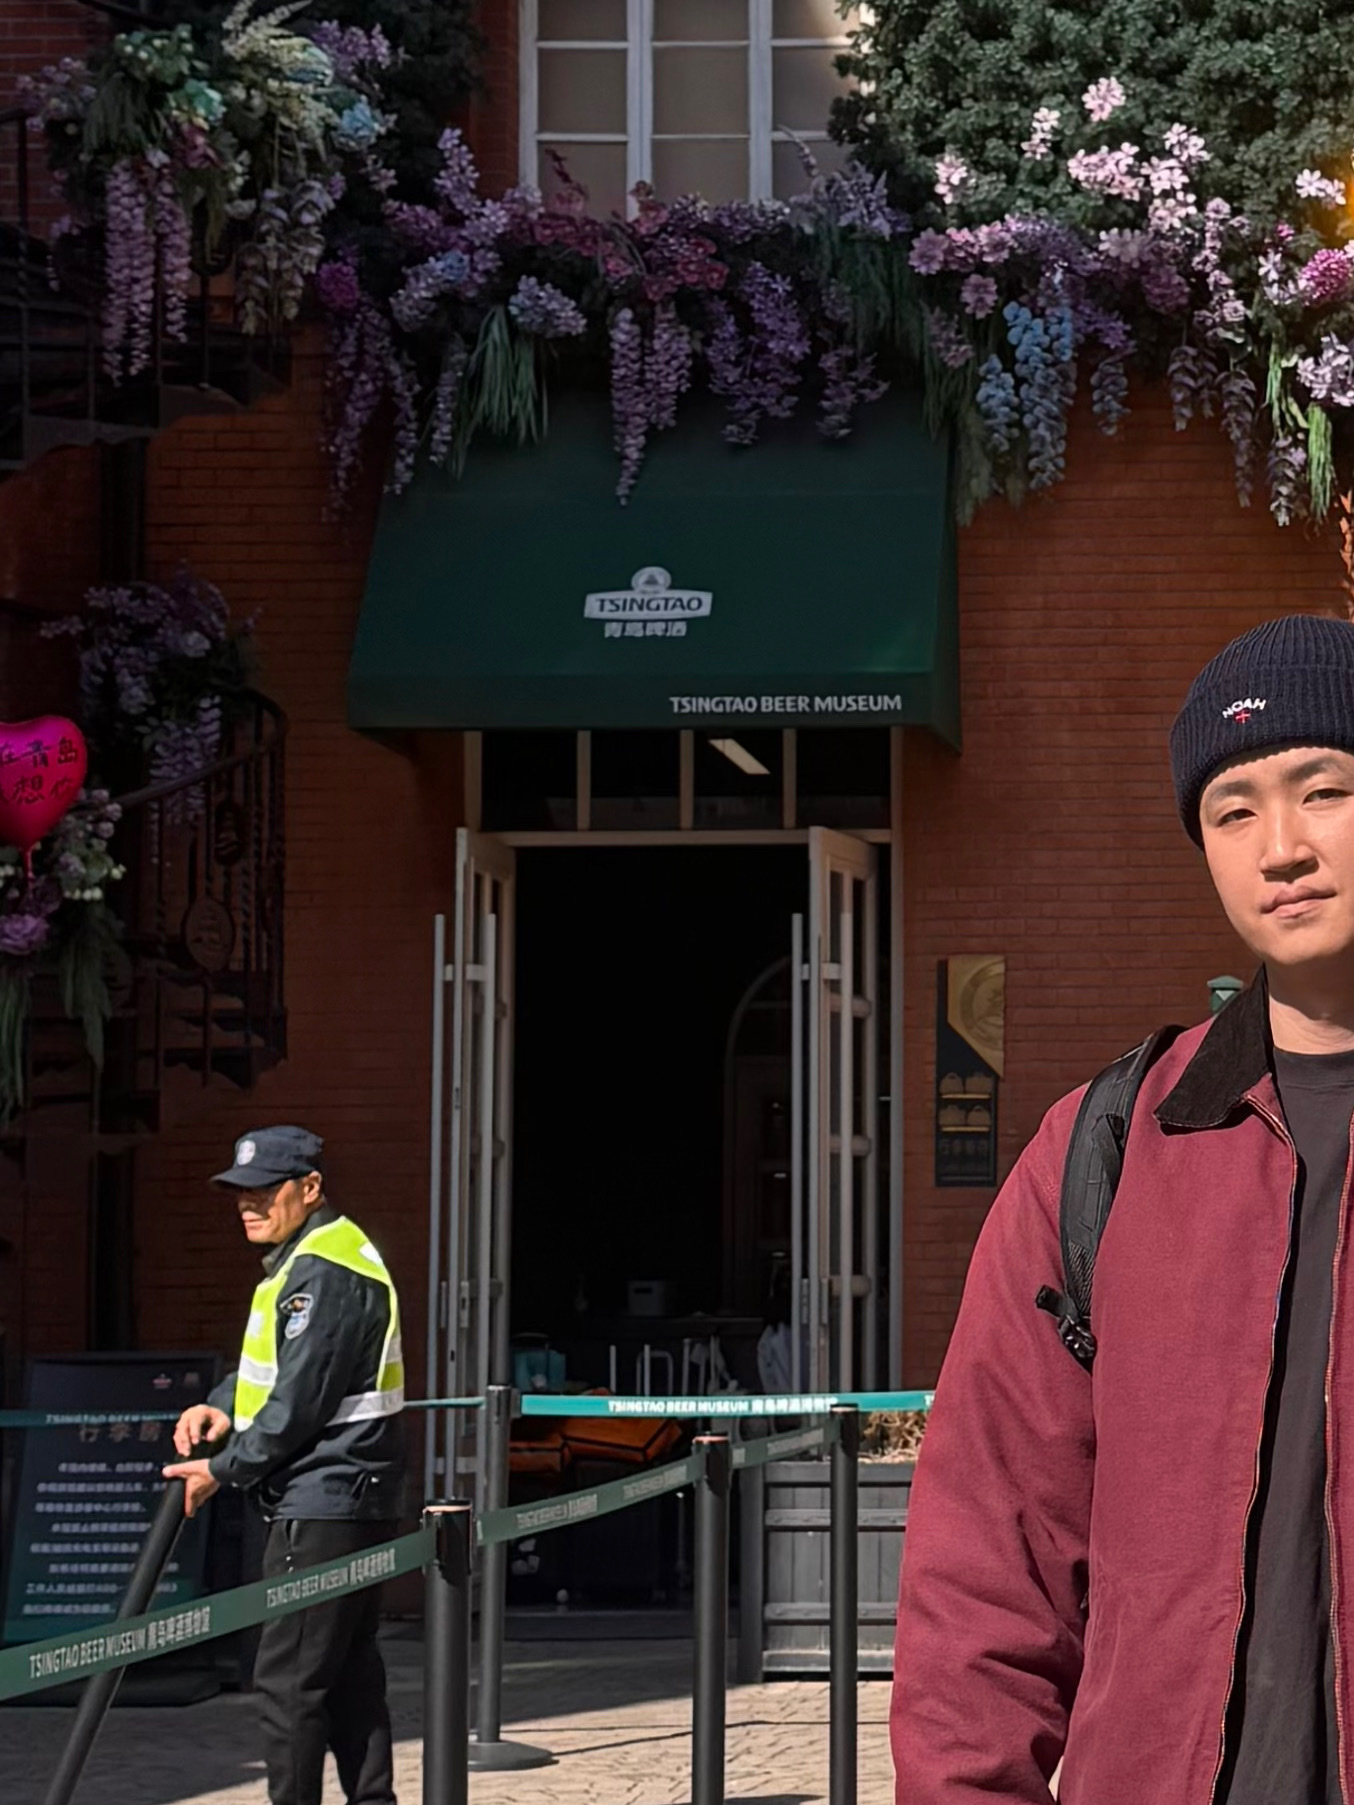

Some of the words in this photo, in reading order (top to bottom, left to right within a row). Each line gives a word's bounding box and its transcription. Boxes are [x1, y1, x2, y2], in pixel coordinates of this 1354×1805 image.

[595, 597, 703, 613] TSINGTAO
[669, 696, 758, 713] TSINGTAO
[760, 696, 811, 713] BEER
[814, 695, 902, 712] MUSEUM
[1222, 697, 1267, 719] NOAH
[608, 1400, 665, 1413] TSINGTAO
[666, 1400, 697, 1413] BEER
[698, 1400, 749, 1413] MUSEUM
[29, 1644, 79, 1679] TSINGTAO
[79, 1637, 106, 1666] BEER
[105, 1627, 147, 1659] MUSEUM
